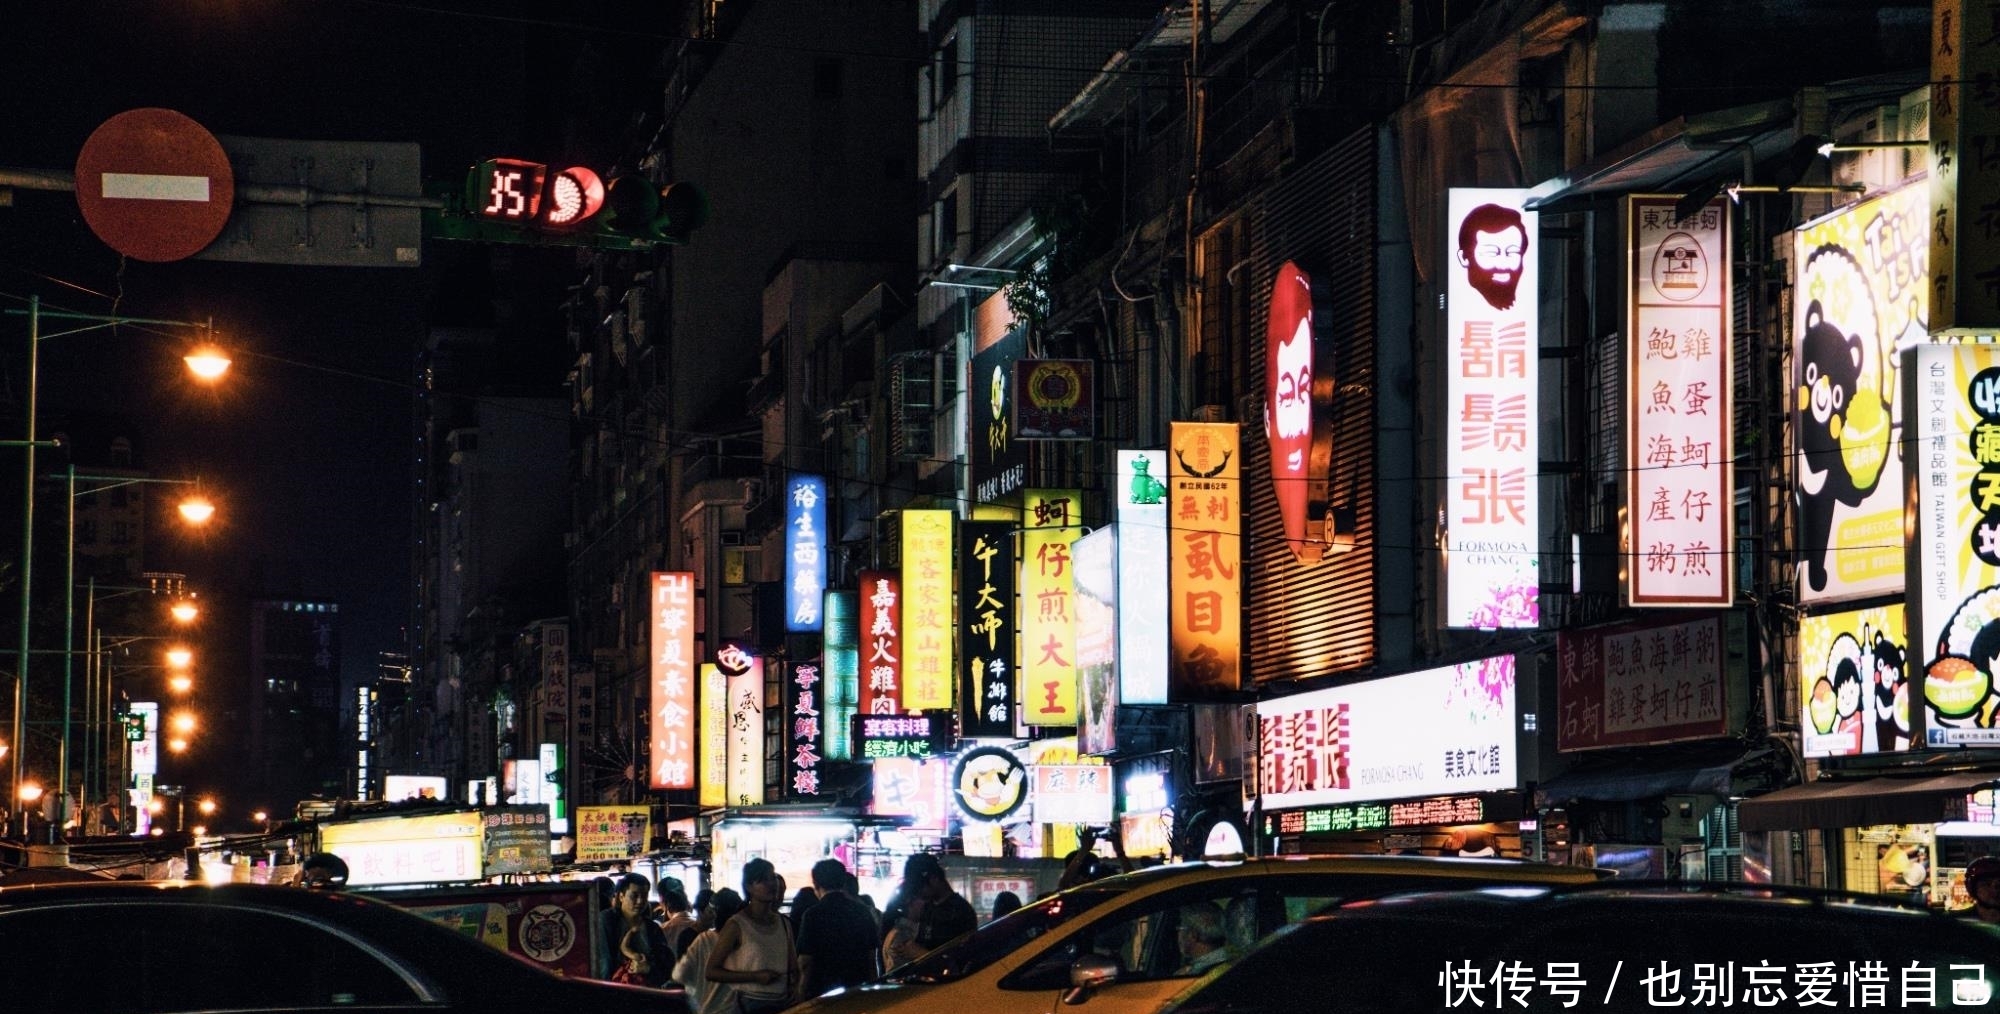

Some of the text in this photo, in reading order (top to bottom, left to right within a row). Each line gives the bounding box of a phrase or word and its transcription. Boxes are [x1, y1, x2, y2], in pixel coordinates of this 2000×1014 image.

[485, 170, 524, 216] 35
[1642, 208, 1719, 231] 東石鮮蚵
[1460, 320, 1527, 526] 鬍鬚張
[1646, 327, 1678, 575] 鮑魚海產粥
[1680, 327, 1713, 577] 雞蛋蚵仔煎
[1178, 495, 1229, 522] 無刺
[793, 483, 820, 625] 裕生西藥房
[1459, 540, 1527, 553] FORMOSA
[1467, 555, 1519, 566] CHANG
[1934, 493, 1947, 601] TAIWAN GIFT SHOP
[915, 557, 943, 702] 客家放山雞莊
[1034, 497, 1072, 714] 蚵仔煎大王
[1183, 530, 1234, 684] 虱目魚
[868, 578, 898, 715] 嘉義火雞肉
[1607, 626, 1716, 677] 鮑魚海鮮粥
[987, 658, 1008, 722] 牛排館
[1562, 640, 1579, 740] 東石
[1581, 634, 1600, 741] 鮮蚵
[1608, 674, 1717, 726] 雞蛋蚵仔煎
[792, 664, 821, 795] 寧夏鮮茶棧
[864, 718, 931, 736] 宴客料理
[864, 740, 931, 758] 經濟小吃
[1361, 763, 1425, 785] FORMOSA CHANG
[1445, 744, 1500, 779] 美食文化館
[340, 847, 446, 878] 飲料吧
